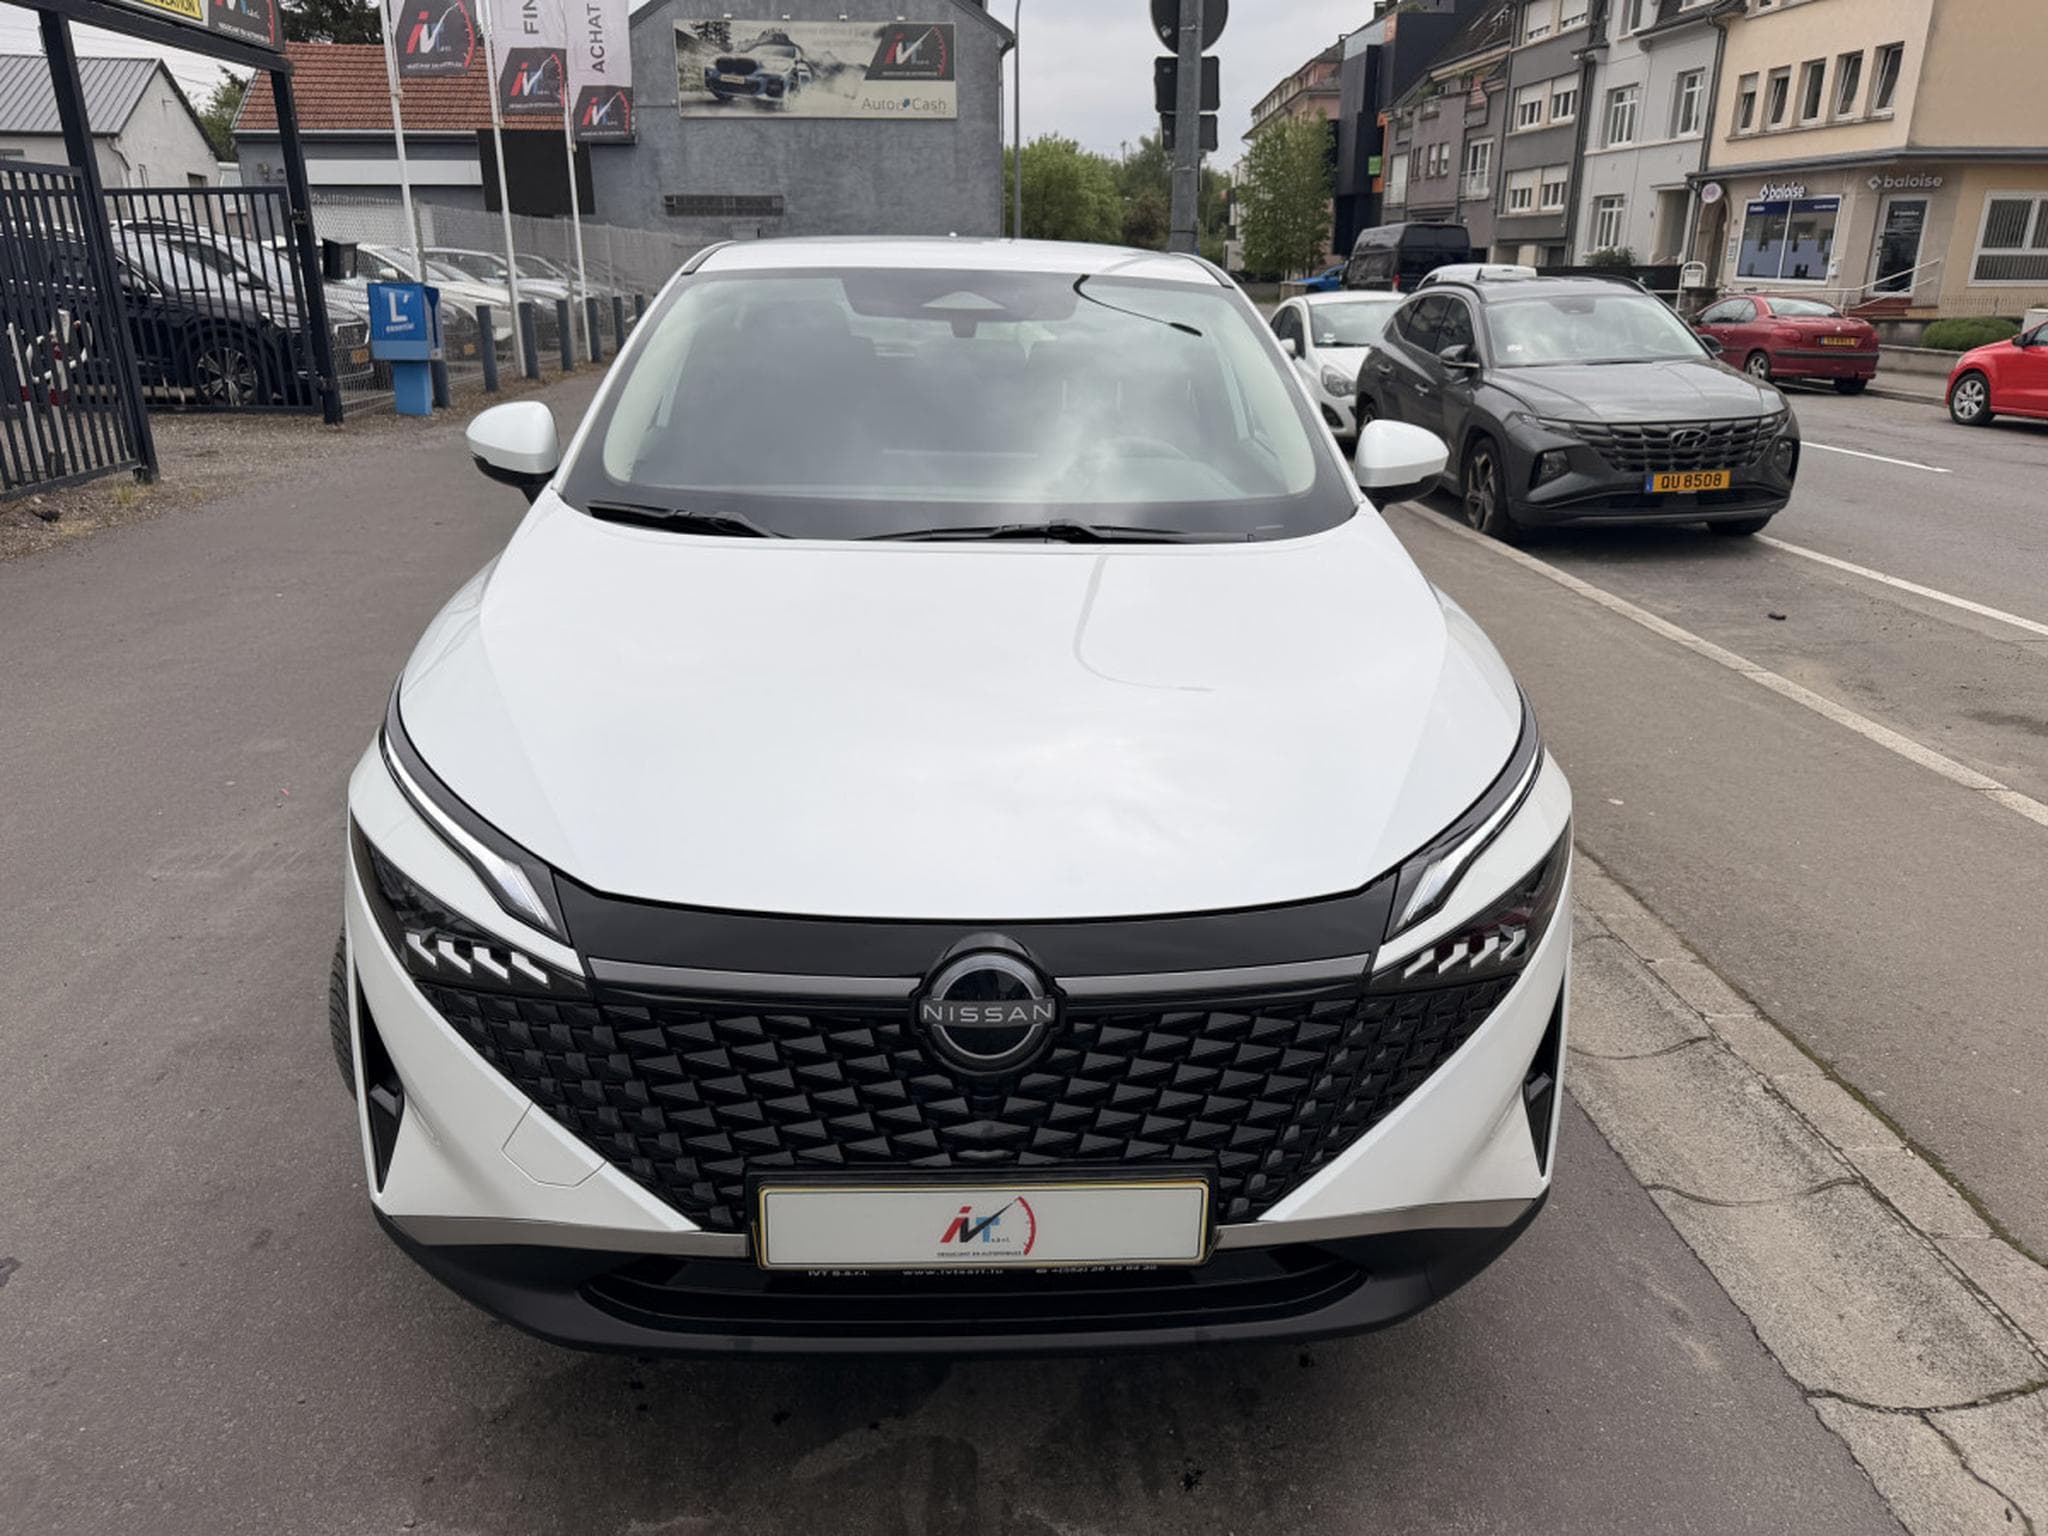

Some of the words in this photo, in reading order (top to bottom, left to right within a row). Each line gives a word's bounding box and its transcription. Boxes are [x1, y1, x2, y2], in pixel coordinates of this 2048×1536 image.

[586, 3, 605, 74] ACHAT
[1883, 172, 1943, 188] baloise
[1683, 472, 1723, 488] 8508
[922, 1003, 1052, 1023] NISSAN
